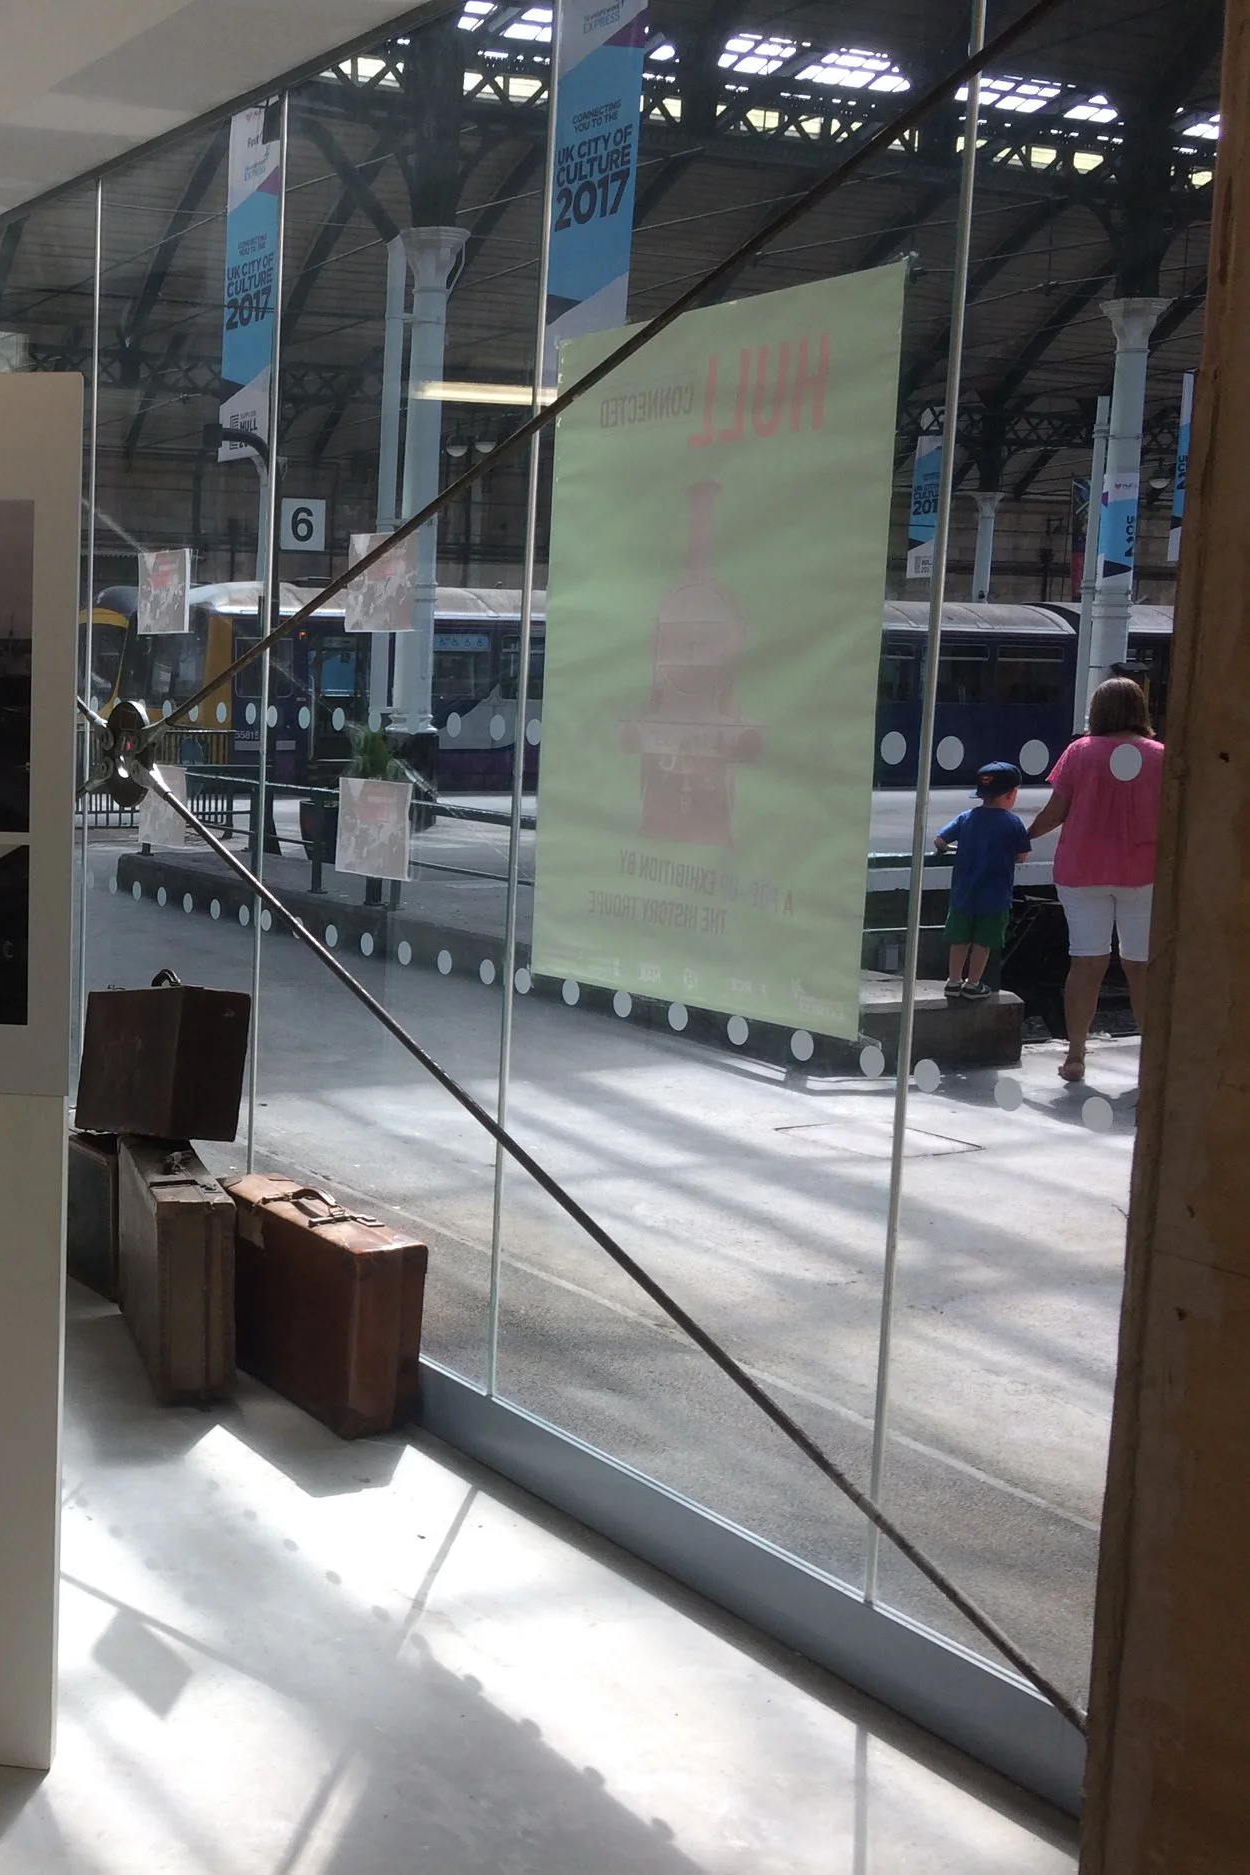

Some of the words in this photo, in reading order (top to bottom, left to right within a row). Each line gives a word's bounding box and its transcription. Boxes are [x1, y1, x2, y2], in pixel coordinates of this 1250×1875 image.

[583, 11, 621, 34] EXPRESS
[572, 100, 622, 125] CONNECTING
[574, 119, 591, 134] YOU
[591, 115, 603, 128] TO
[604, 110, 619, 123] THE
[557, 144, 576, 166] UK
[577, 132, 612, 160] CITY
[613, 123, 633, 144] OF
[556, 143, 632, 188] CULTURE
[555, 167, 631, 232] 2017
[227, 263, 241, 281] UK
[241, 257, 262, 277] CITY
[262, 252, 274, 268] OF
[227, 267, 274, 298] CULTURE
[226, 285, 273, 331] 2017
[291, 506, 314, 542] 6
